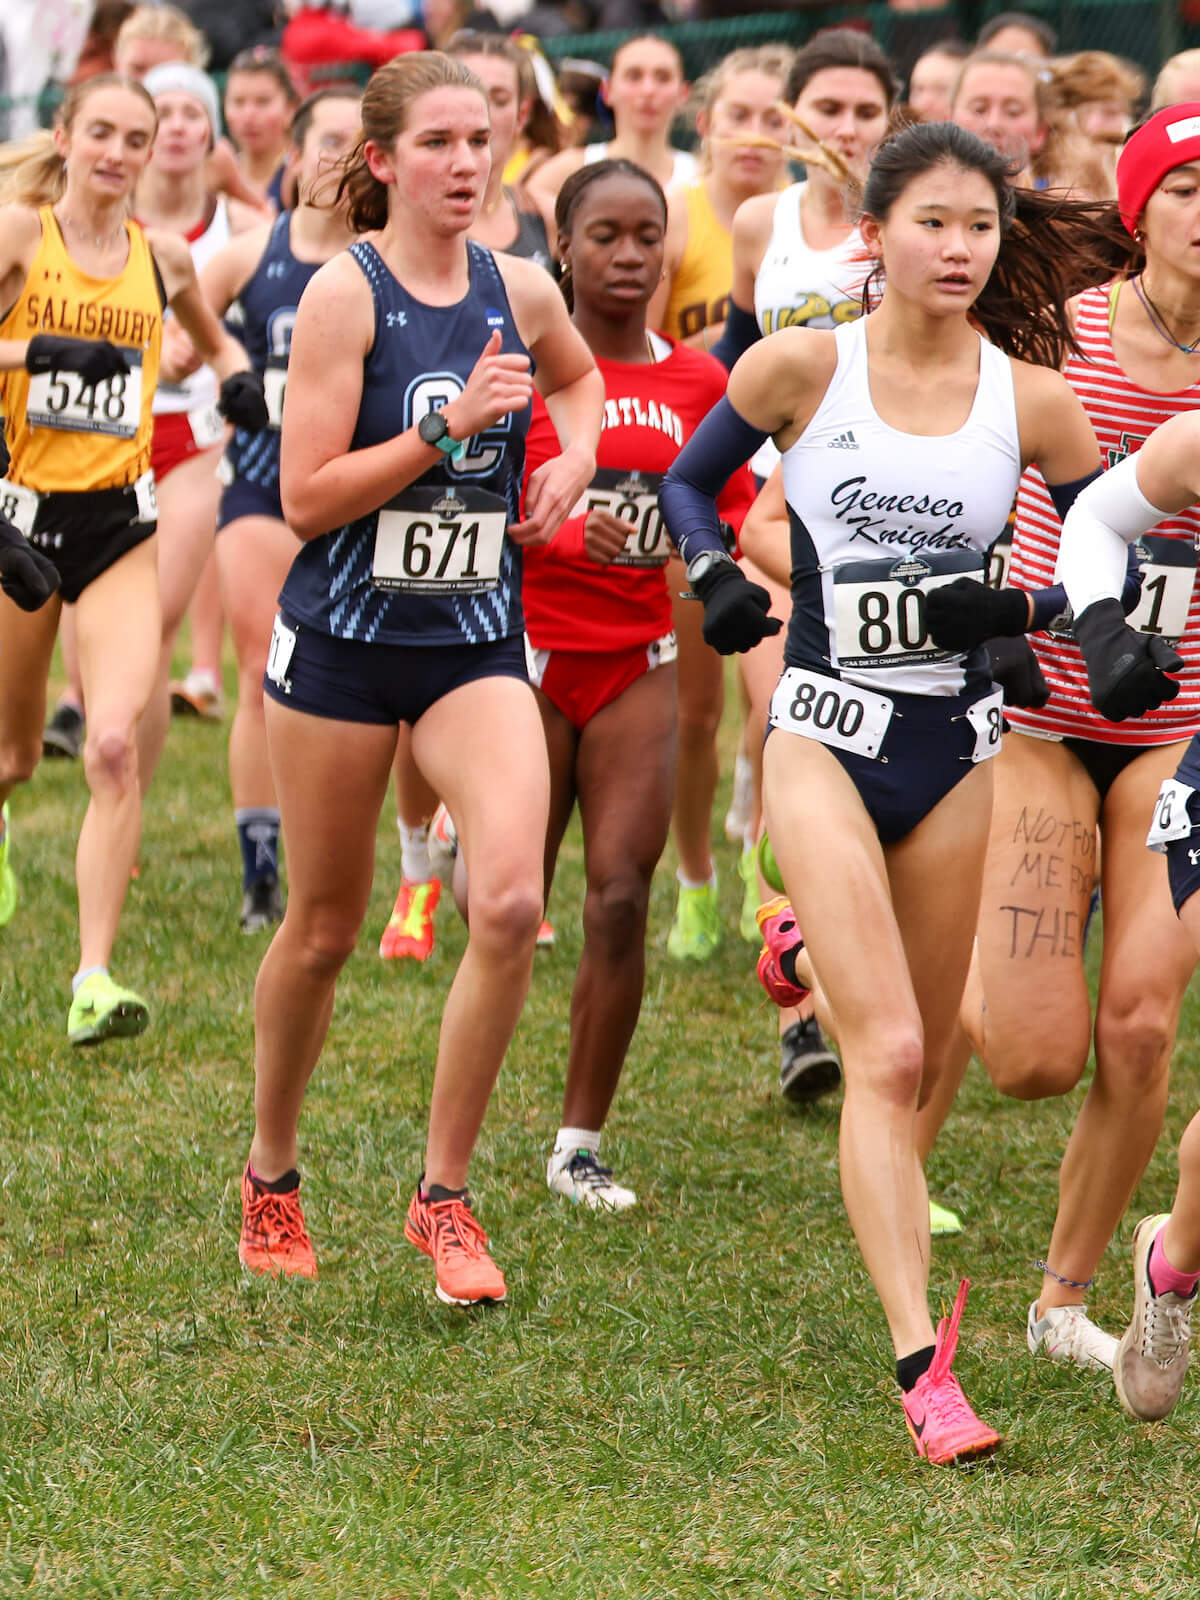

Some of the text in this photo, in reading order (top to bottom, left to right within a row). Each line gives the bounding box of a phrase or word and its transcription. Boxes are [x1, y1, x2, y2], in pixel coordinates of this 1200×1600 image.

[27, 293, 156, 344] SALISBURY
[46, 369, 126, 422] 548
[601, 398, 682, 447] RTLAND
[827, 439, 859, 449] adidas
[831, 476, 963, 519] Geneseo
[402, 521, 479, 579] 671
[858, 588, 930, 654] 80
[790, 683, 864, 737] 800
[1013, 806, 1071, 847] NOT
[1010, 853, 1064, 888] ME
